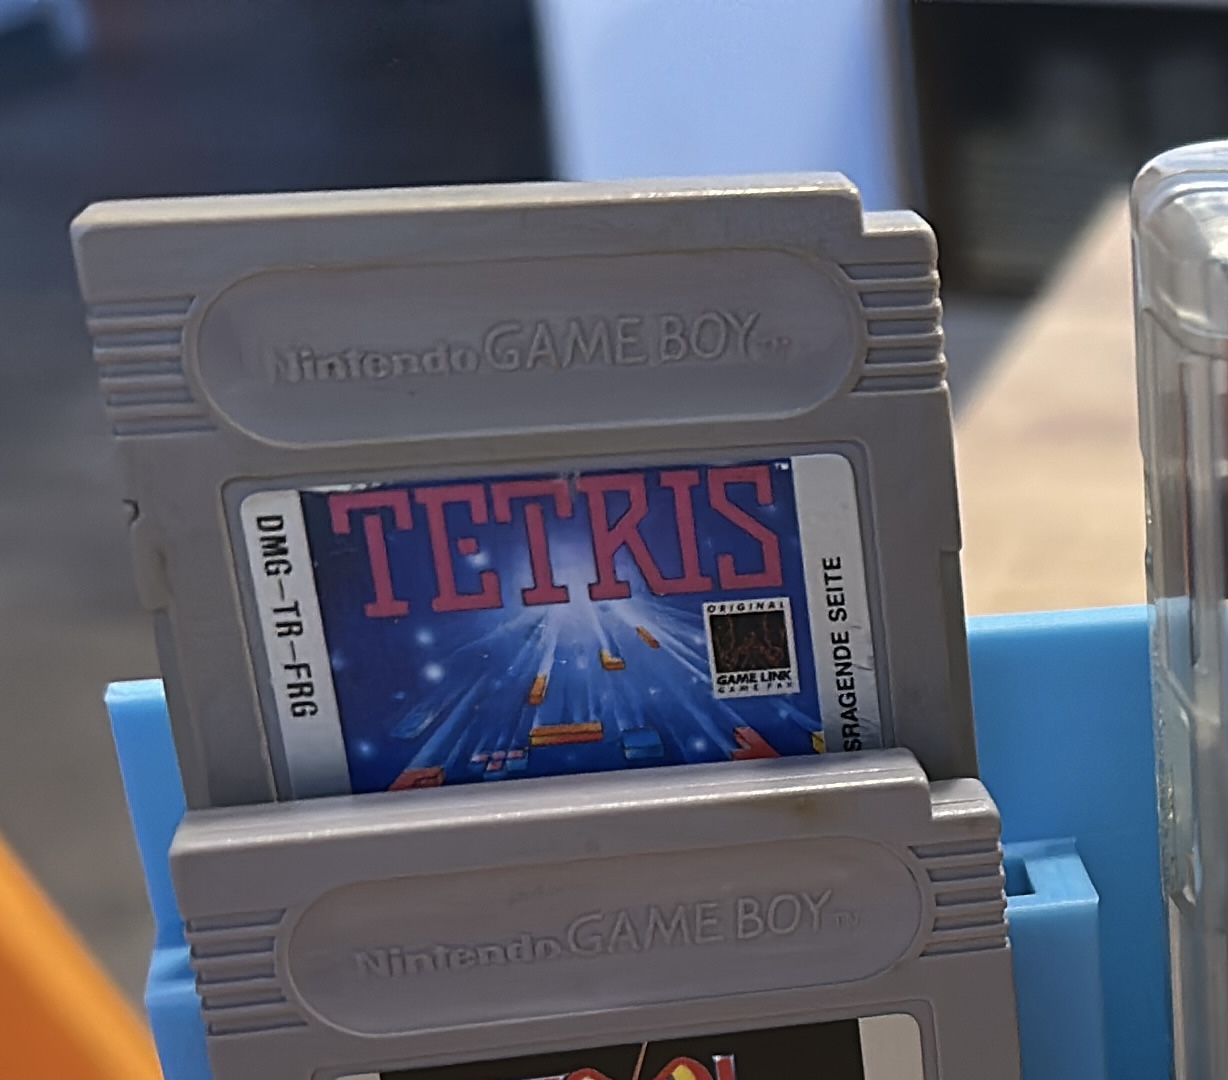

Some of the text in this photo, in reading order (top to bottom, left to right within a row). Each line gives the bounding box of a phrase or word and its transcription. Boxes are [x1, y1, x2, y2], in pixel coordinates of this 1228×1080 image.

[270, 340, 481, 384] Nintendo
[483, 315, 649, 372] GAME
[653, 310, 761, 366] BOY
[327, 465, 785, 618] TETRIS
[256, 514, 318, 718] DMG-TR-FRG
[706, 601, 786, 614] ORIGINAL
[716, 670, 792, 686] GAME LINK
[822, 555, 861, 751] SRAGENDE SEITE
[356, 932, 561, 977] Nintendo
[567, 902, 724, 956] GAME
[735, 889, 832, 940] BOY
